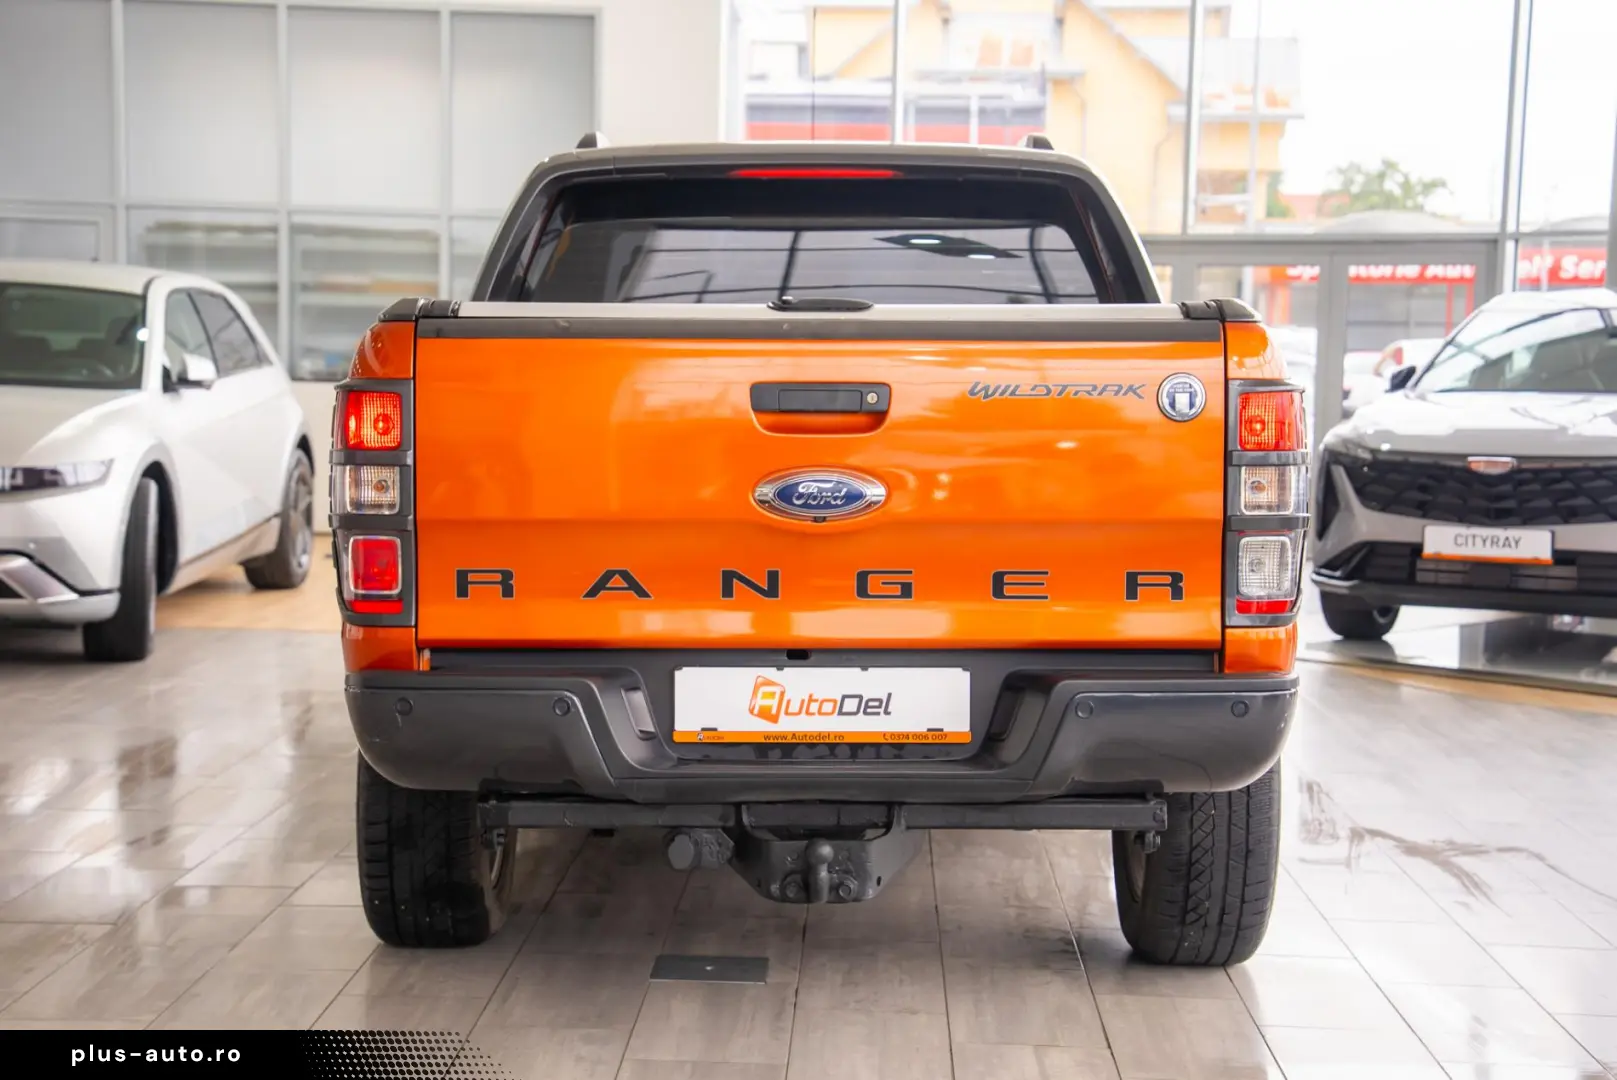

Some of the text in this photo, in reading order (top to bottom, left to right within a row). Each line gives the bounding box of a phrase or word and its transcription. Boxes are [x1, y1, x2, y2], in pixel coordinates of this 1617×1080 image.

[1558, 254, 1606, 279] Ser
[967, 380, 1147, 401] WILDTRAK
[792, 481, 848, 505] Ford
[1453, 533, 1522, 550] CITYRAY
[455, 568, 1186, 601] RANGER
[750, 681, 892, 718] AutoDel
[763, 732, 845, 742] www.Autodel.ro
[890, 733, 948, 741] 0374 006 007
